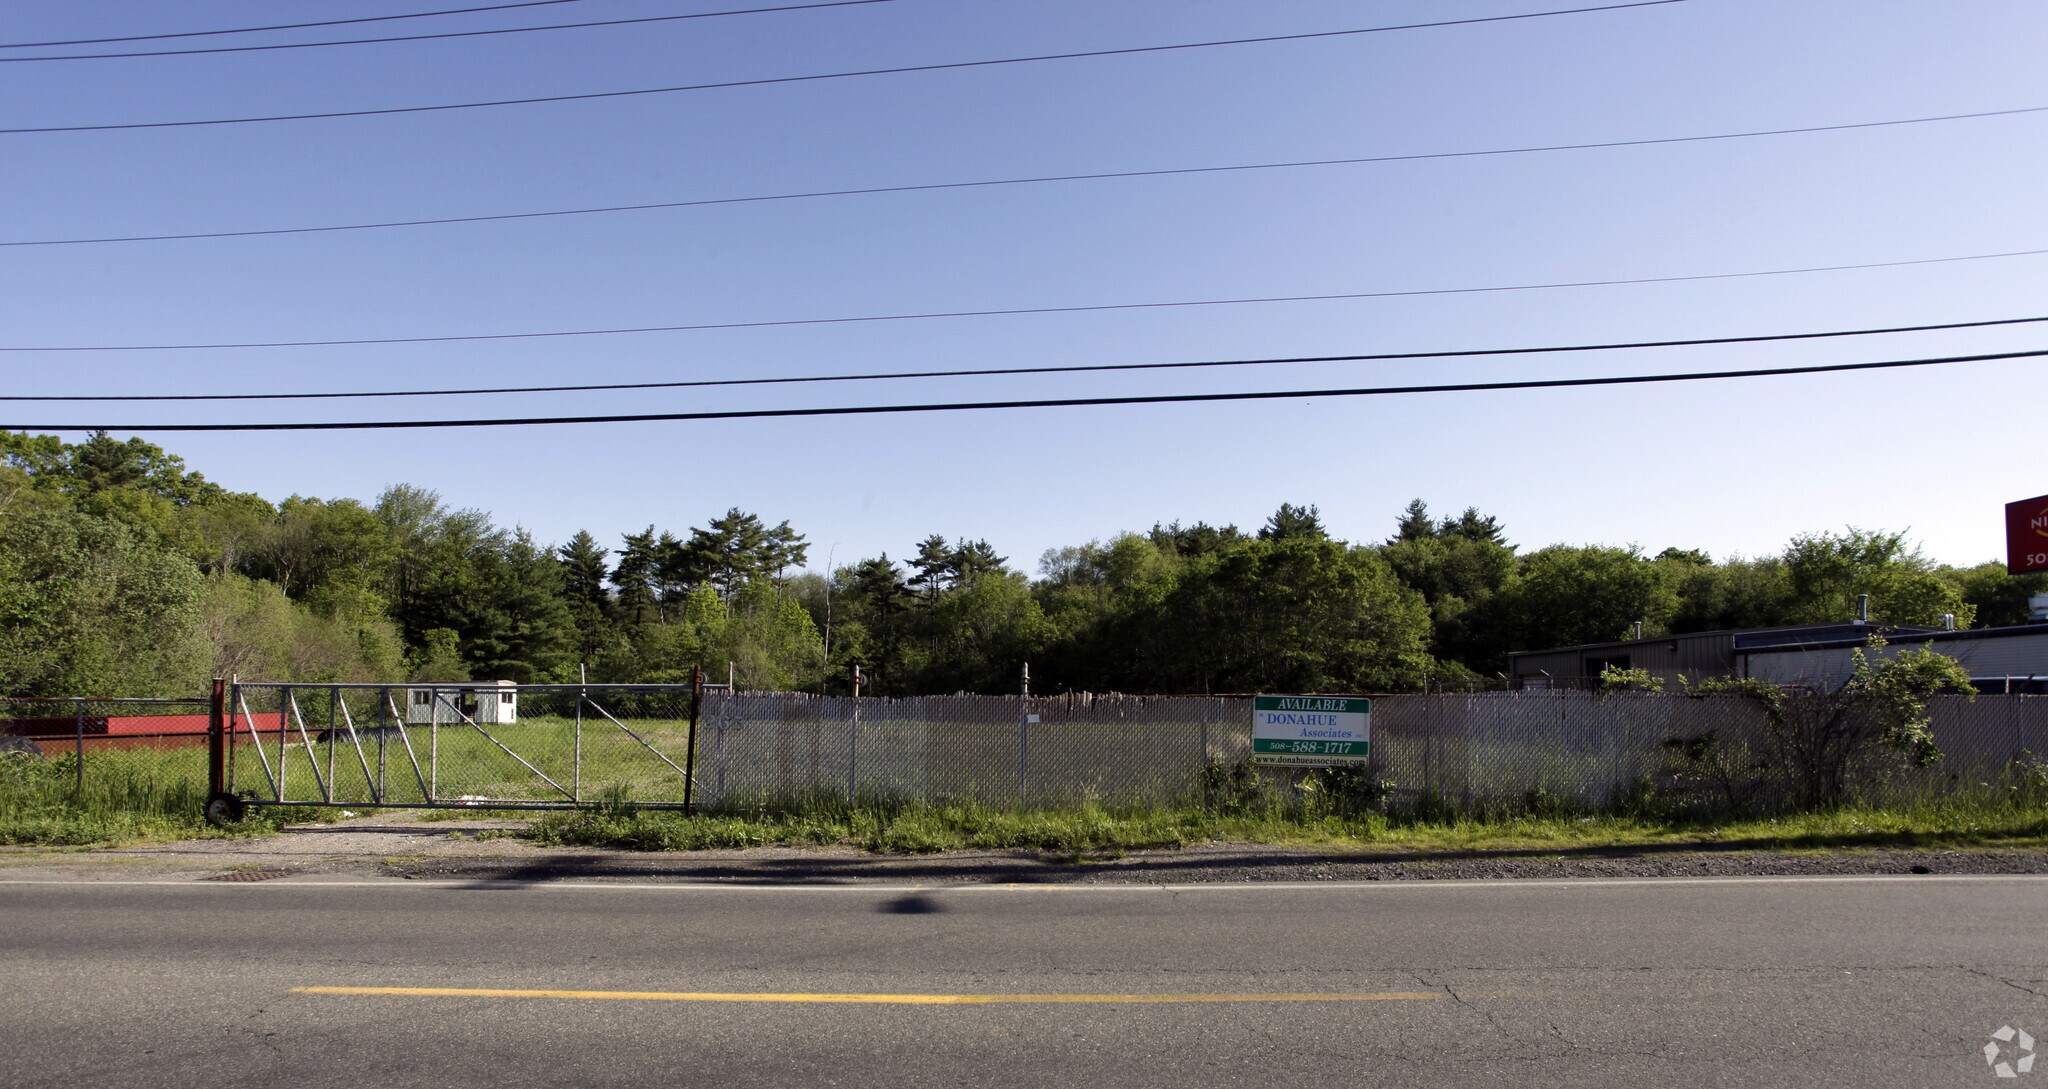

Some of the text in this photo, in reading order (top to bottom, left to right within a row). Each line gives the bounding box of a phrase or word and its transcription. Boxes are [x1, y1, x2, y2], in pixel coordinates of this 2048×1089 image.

[2026, 553, 2048, 566] 50
[1277, 699, 1347, 711] AVAILABLE
[1267, 714, 1337, 725] DONAHUE
[1300, 728, 1352, 738] Associates
[1269, 741, 1352, 754] 508-588-1717
[1256, 756, 1365, 766] www.donahueassociates.com
